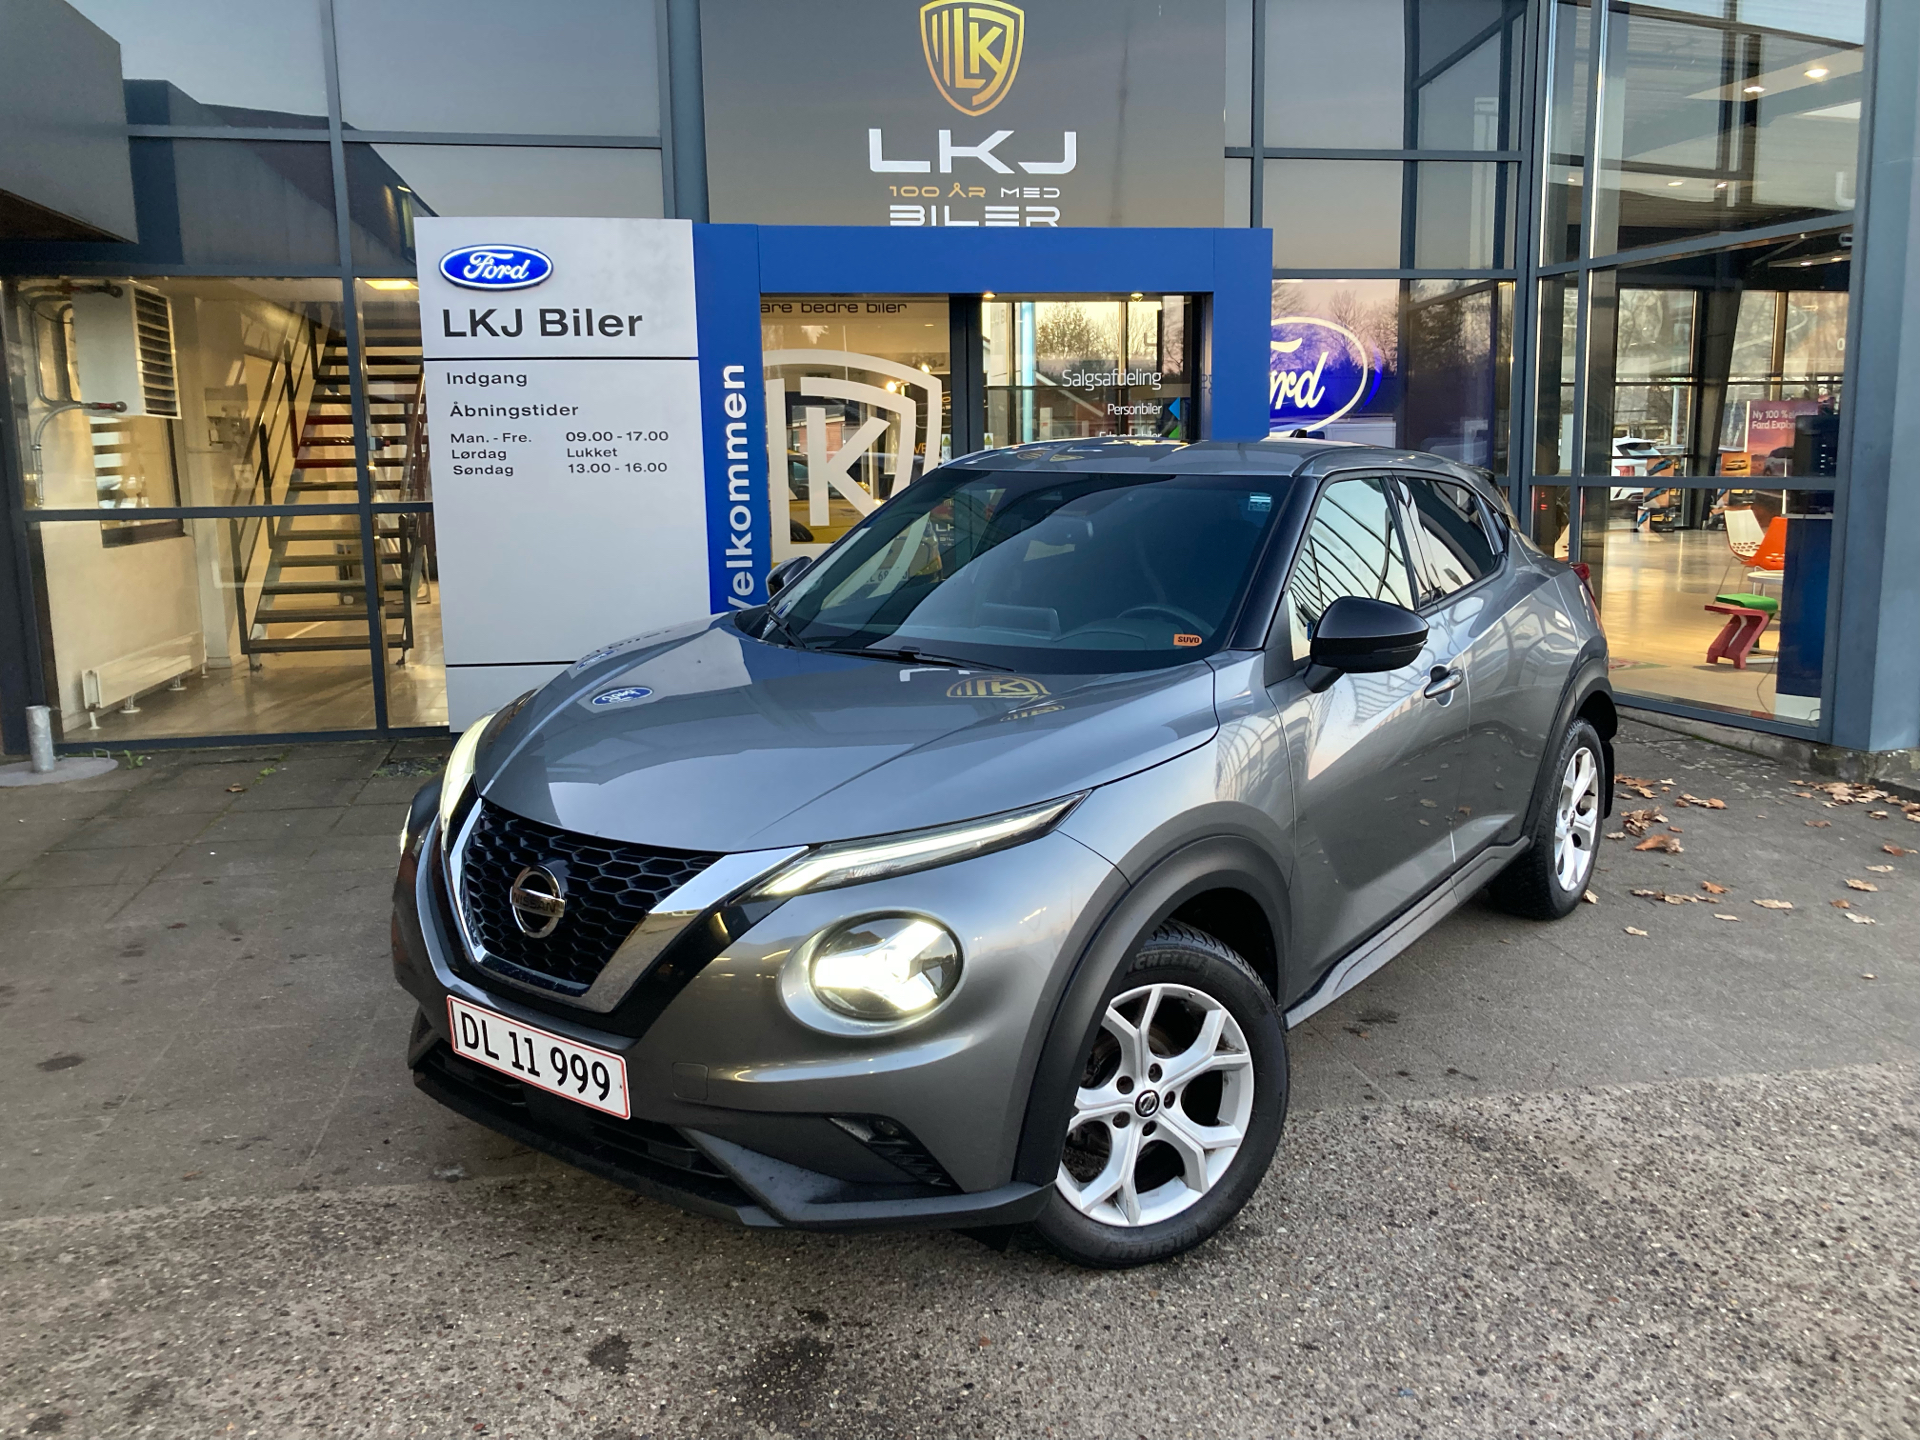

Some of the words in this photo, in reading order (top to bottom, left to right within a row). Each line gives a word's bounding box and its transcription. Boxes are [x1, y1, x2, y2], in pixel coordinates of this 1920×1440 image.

[869, 128, 1077, 174] LKJ
[889, 186, 940, 197] 100
[1000, 187, 1061, 198] MED
[889, 205, 1061, 227] BILER
[463, 251, 531, 280] Ford
[801, 302, 859, 314] bedre
[866, 302, 908, 314] biler
[442, 308, 523, 338] LKJ
[539, 308, 643, 338] Biler
[446, 372, 528, 388] Indgang
[1062, 368, 1162, 391] Salgsafdeling
[450, 401, 579, 419] Åbningstider
[1107, 402, 1162, 416] Personbiler
[1752, 410, 1764, 420] Ny
[1765, 410, 1780, 419] 100
[1752, 420, 1771, 430] Ford
[450, 433, 490, 444] Man.
[502, 432, 532, 443] Fre.
[565, 431, 613, 442] 09.00
[626, 431, 669, 442] 17.00
[451, 449, 507, 461] Lørdag
[567, 447, 618, 458] Lukket
[453, 465, 514, 477] Søndag
[568, 463, 611, 474] 13.00
[625, 462, 668, 473] 16.00
[513, 892, 556, 913] NISSAN
[1127, 953, 1207, 973] ICHELIN
[461, 1013, 499, 1060] DL
[509, 1031, 540, 1078] 11
[550, 1046, 611, 1102] 999
